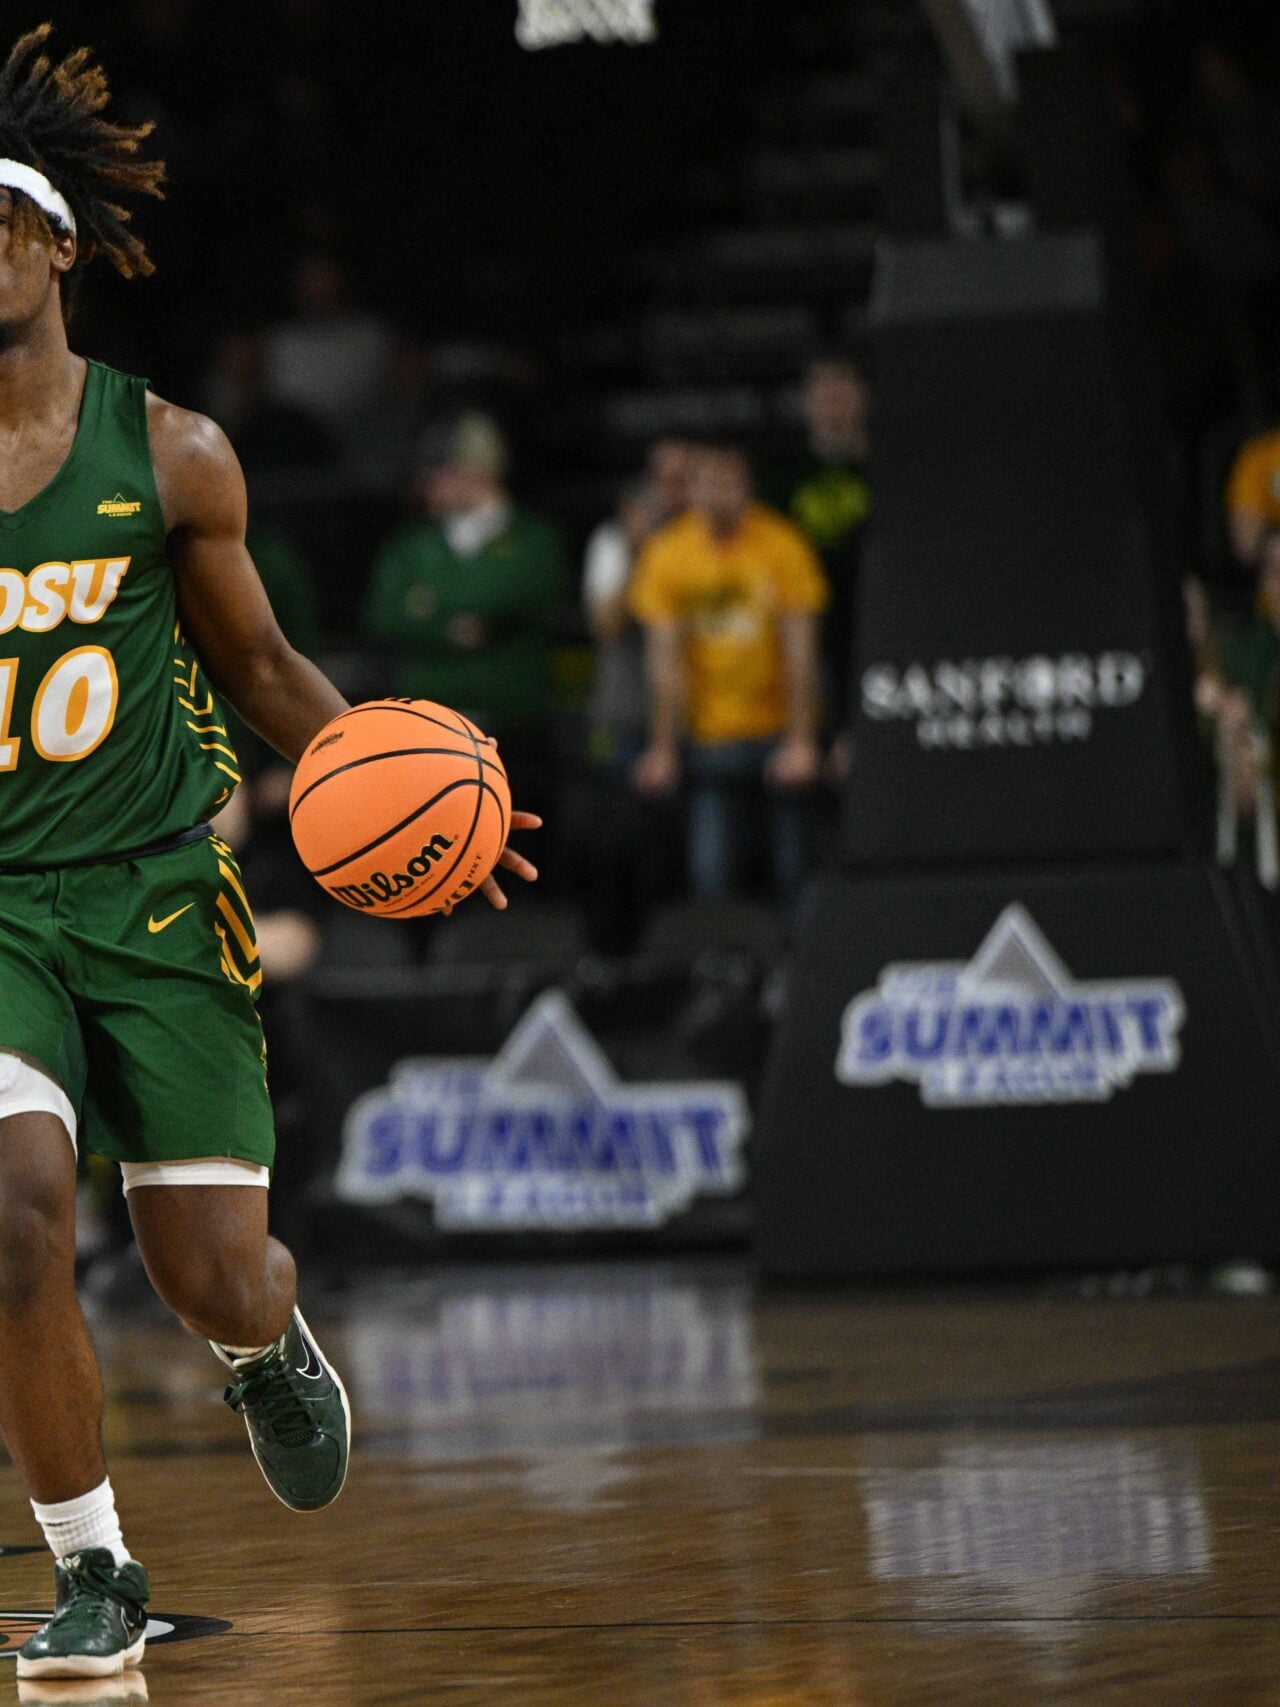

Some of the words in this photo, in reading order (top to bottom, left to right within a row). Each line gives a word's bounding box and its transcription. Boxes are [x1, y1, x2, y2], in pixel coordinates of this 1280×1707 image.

[97, 502, 141, 514] SUMMIT
[861, 651, 1144, 720] SANFORD
[329, 832, 454, 908] Wilson
[856, 996, 1166, 1062] SUMMIT
[364, 1105, 726, 1176] SUMMIT
